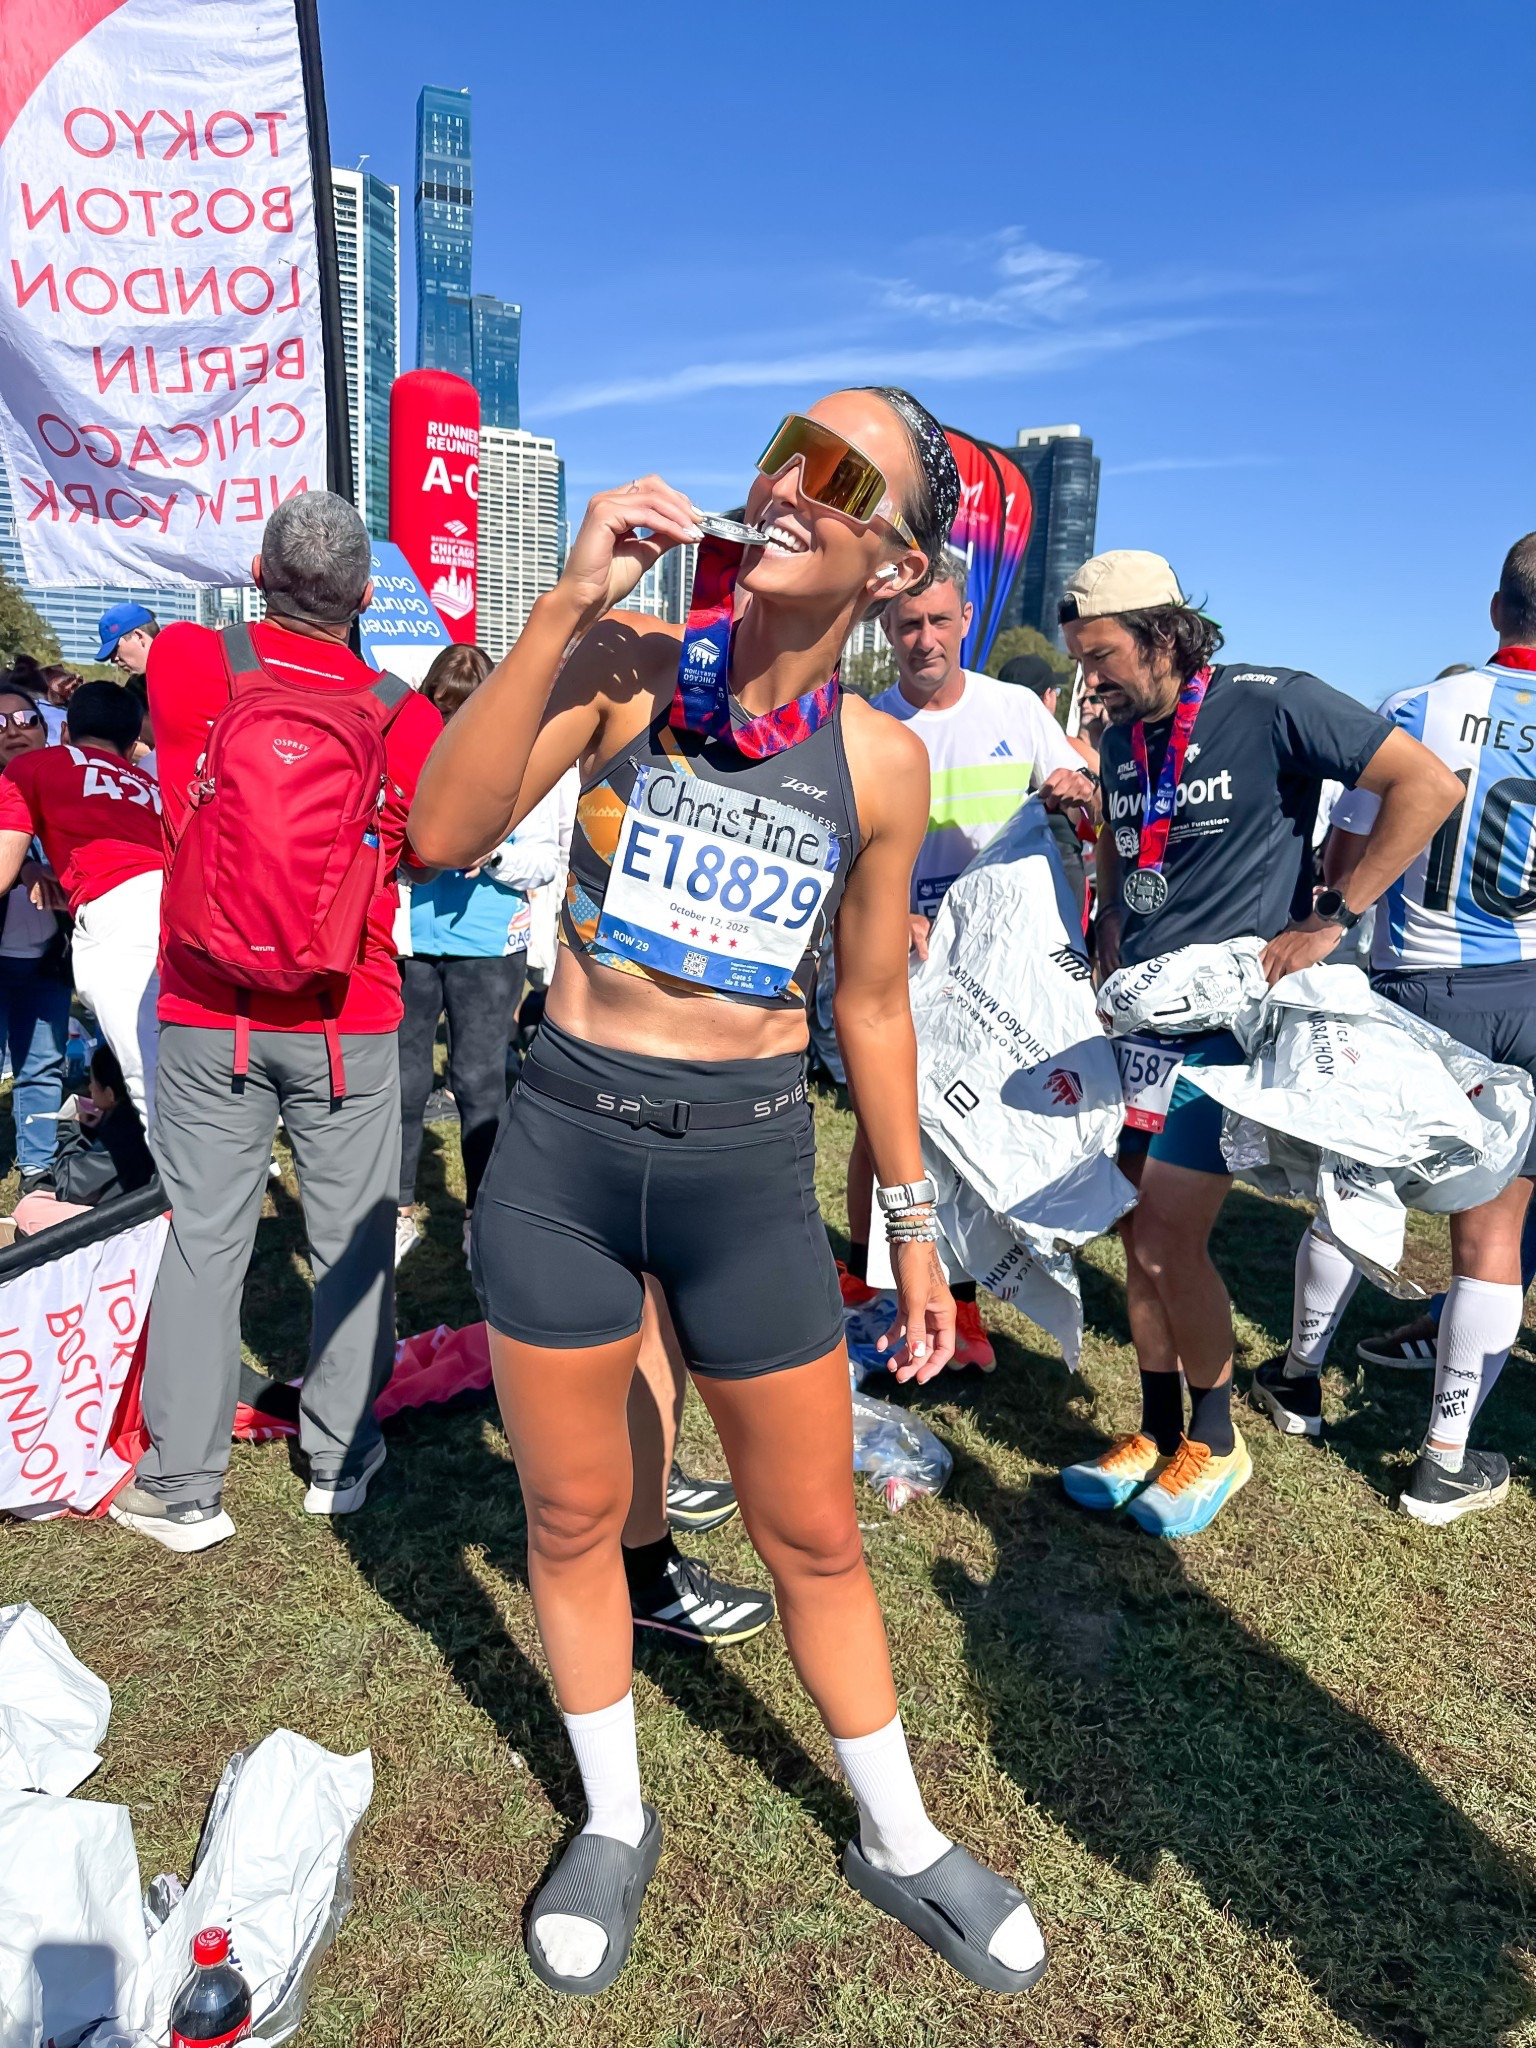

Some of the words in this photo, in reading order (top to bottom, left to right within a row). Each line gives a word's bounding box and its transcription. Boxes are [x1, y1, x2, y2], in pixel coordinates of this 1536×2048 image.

[430, 542, 475, 560] CHICAGO
[683, 673, 716, 684] CHICAGO
[273, 738, 311, 752] OSPREY
[1173, 769, 1233, 817] port
[647, 774, 820, 867] Christine
[1191, 817, 1230, 828] Function
[1119, 835, 1133, 850] 35
[1423, 767, 1536, 919] 10
[621, 820, 823, 930] E18829
[669, 902, 707, 922] October
[709, 916, 723, 930] 12,
[726, 921, 750, 934] 2025
[612, 929, 636, 947] ROW
[635, 940, 650, 952] 29
[731, 972, 747, 982] Gate
[764, 976, 772, 986] 9
[1115, 956, 1172, 1012] CHICAGO
[956, 993, 995, 1034] AMERICA
[996, 1010, 1052, 1065] CHICAGO
[1307, 1010, 1335, 1076] MARATHON
[1006, 1045, 1036, 1076] BANK
[1440, 1400, 1467, 1419] ME!
